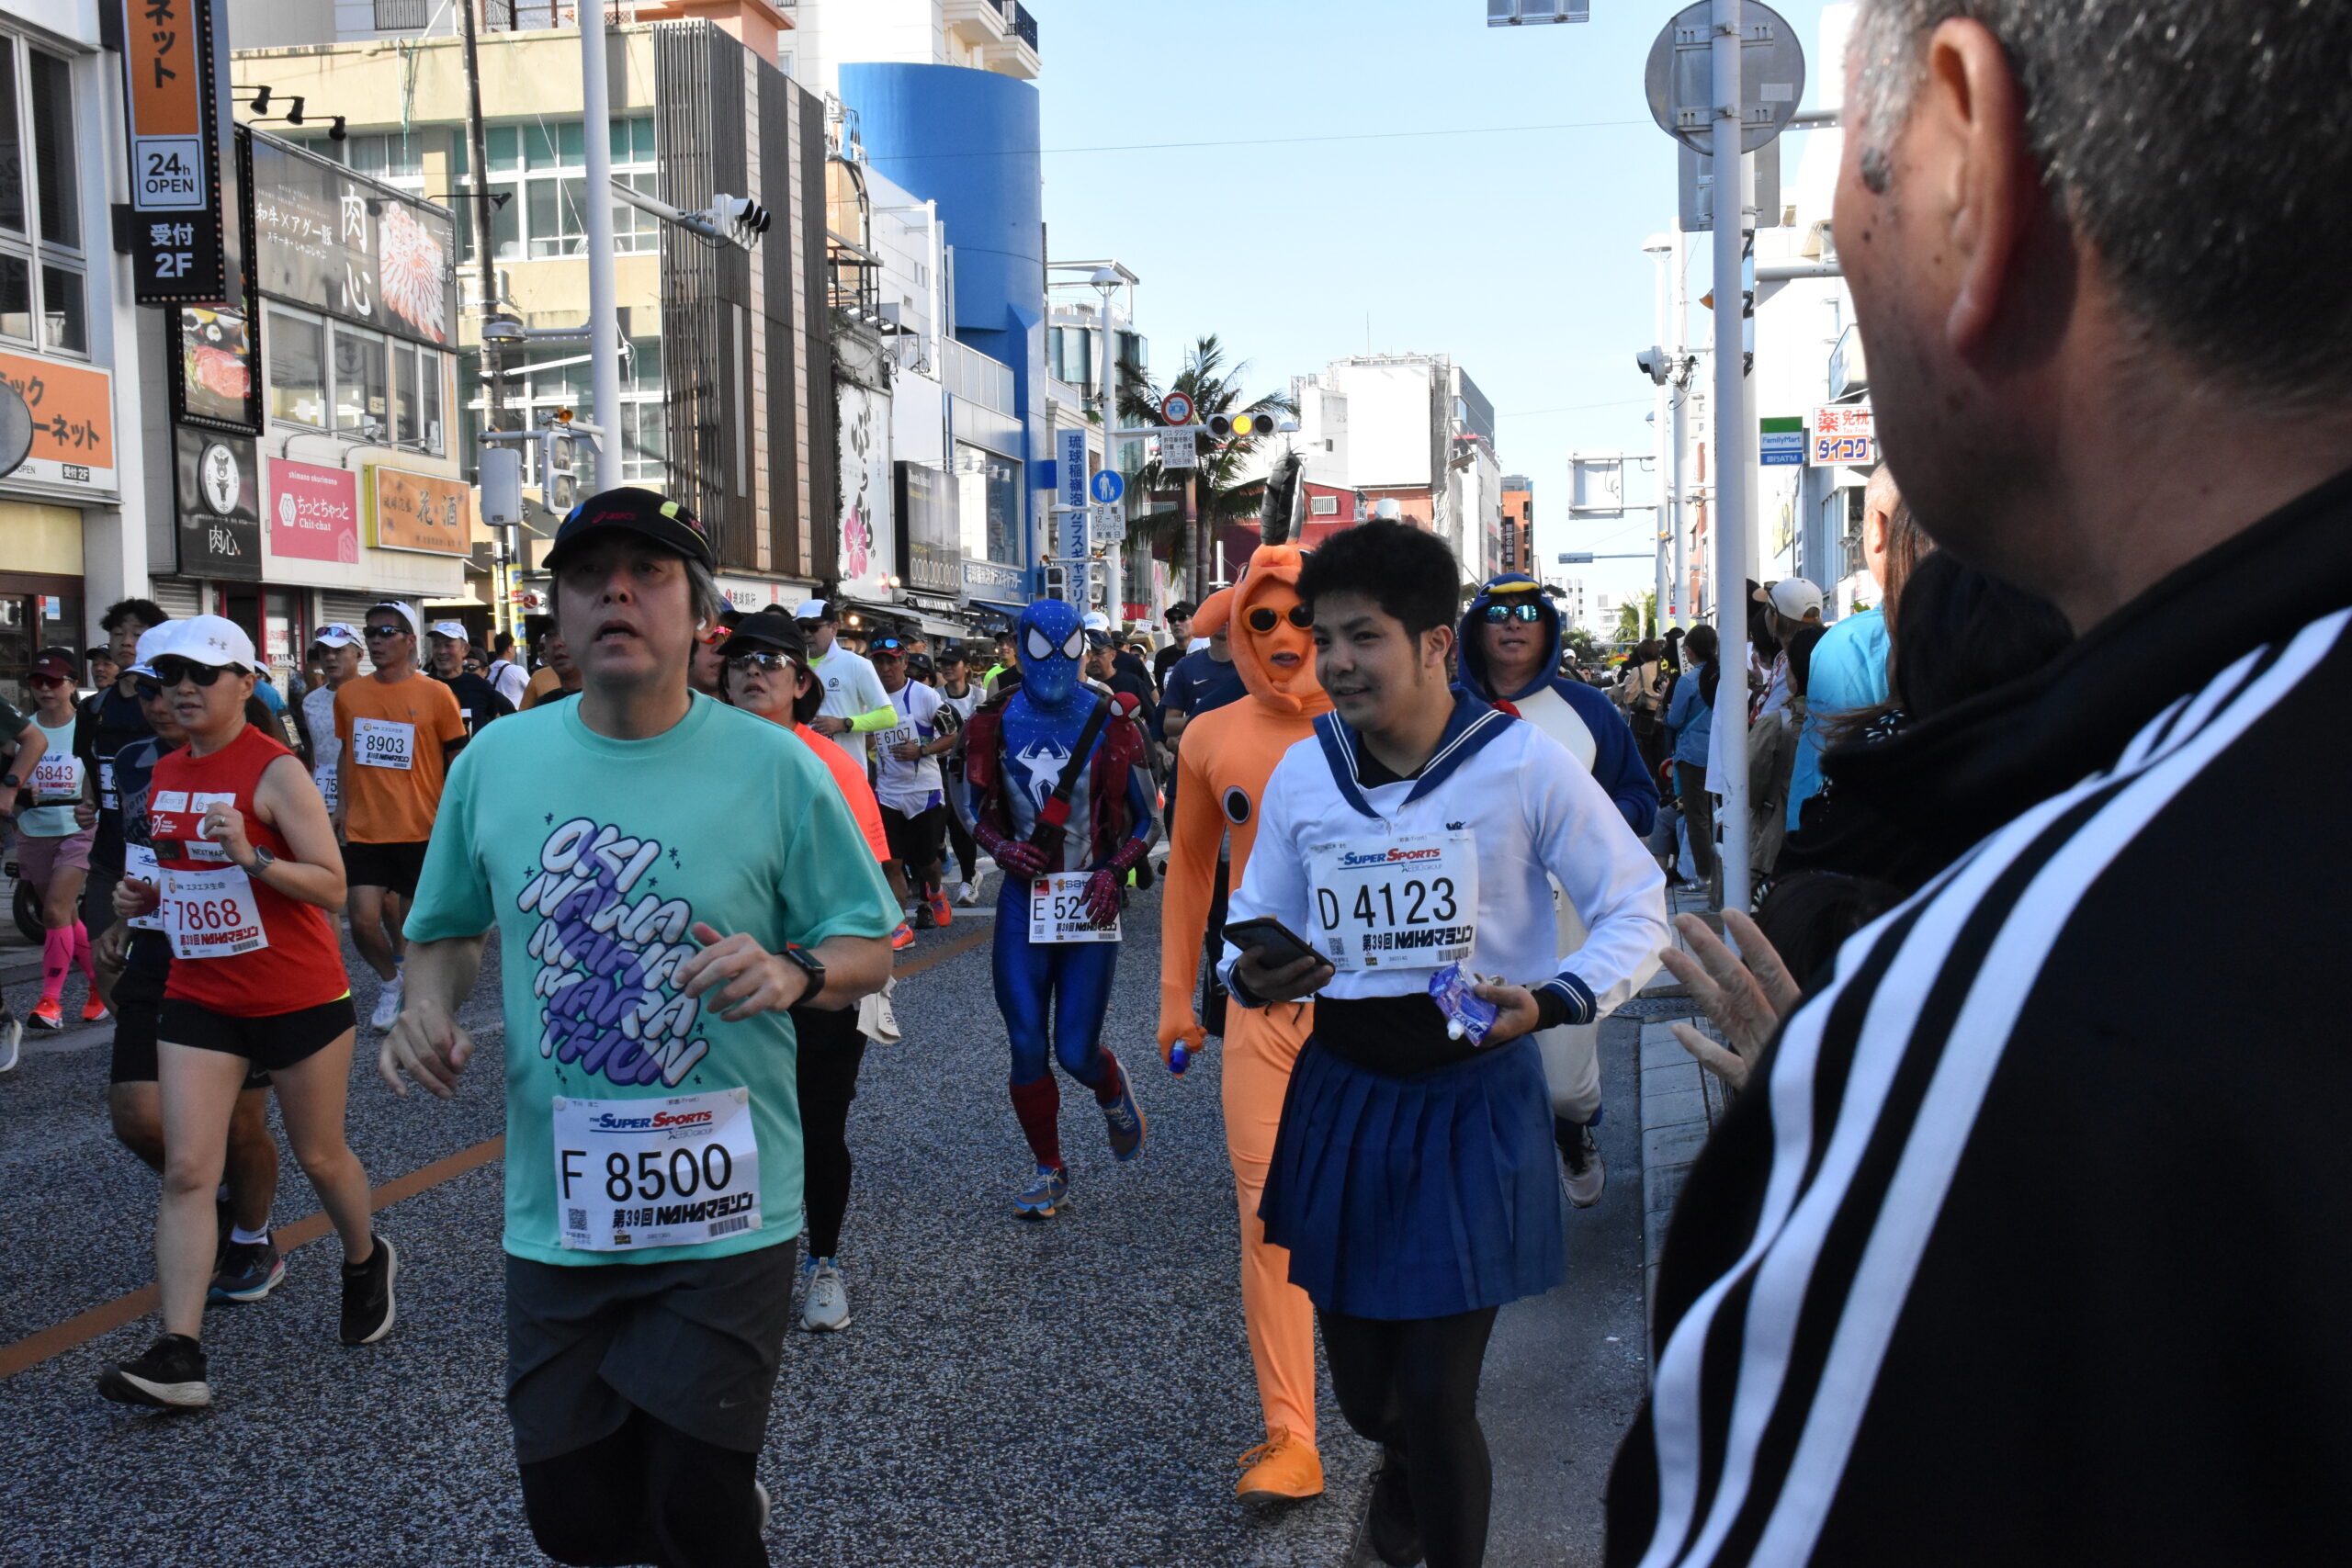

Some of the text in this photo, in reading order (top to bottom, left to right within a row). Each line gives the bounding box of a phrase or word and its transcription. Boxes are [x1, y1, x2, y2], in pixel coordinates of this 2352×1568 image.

[148, 152, 190, 175] 24h
[145, 179, 194, 193] OPEN
[150, 222, 194, 246] 受付
[340, 183, 372, 316] 肉心
[154, 253, 193, 277] 2F
[1818, 409, 1838, 433] 薬
[1842, 409, 1870, 425] 免税
[1762, 435, 1800, 445] FamilyMart
[1818, 437, 1867, 459] ダイコク
[78, 468, 89, 479] 2F
[297, 495, 349, 520] ちっとちゃっと
[299, 517, 331, 531] Chit-chat
[209, 525, 238, 556] 肉心
[354, 733, 404, 753] F 8903
[876, 733, 882, 745] E
[36, 765, 74, 780] 6843
[540, 818, 662, 894] OKI
[1344, 851, 1387, 865] SUPER
[1386, 848, 1441, 862] SPORTS
[163, 898, 242, 931] F 7868
[1034, 897, 1046, 921] E
[1317, 877, 1457, 930] D 4123
[1363, 932, 1393, 952] 第39回
[599, 1112, 652, 1129] SUPER
[651, 1111, 712, 1128] SPORTS
[561, 1144, 732, 1202] F 8500
[613, 1191, 754, 1230] 第39回 NAHAマラソン
